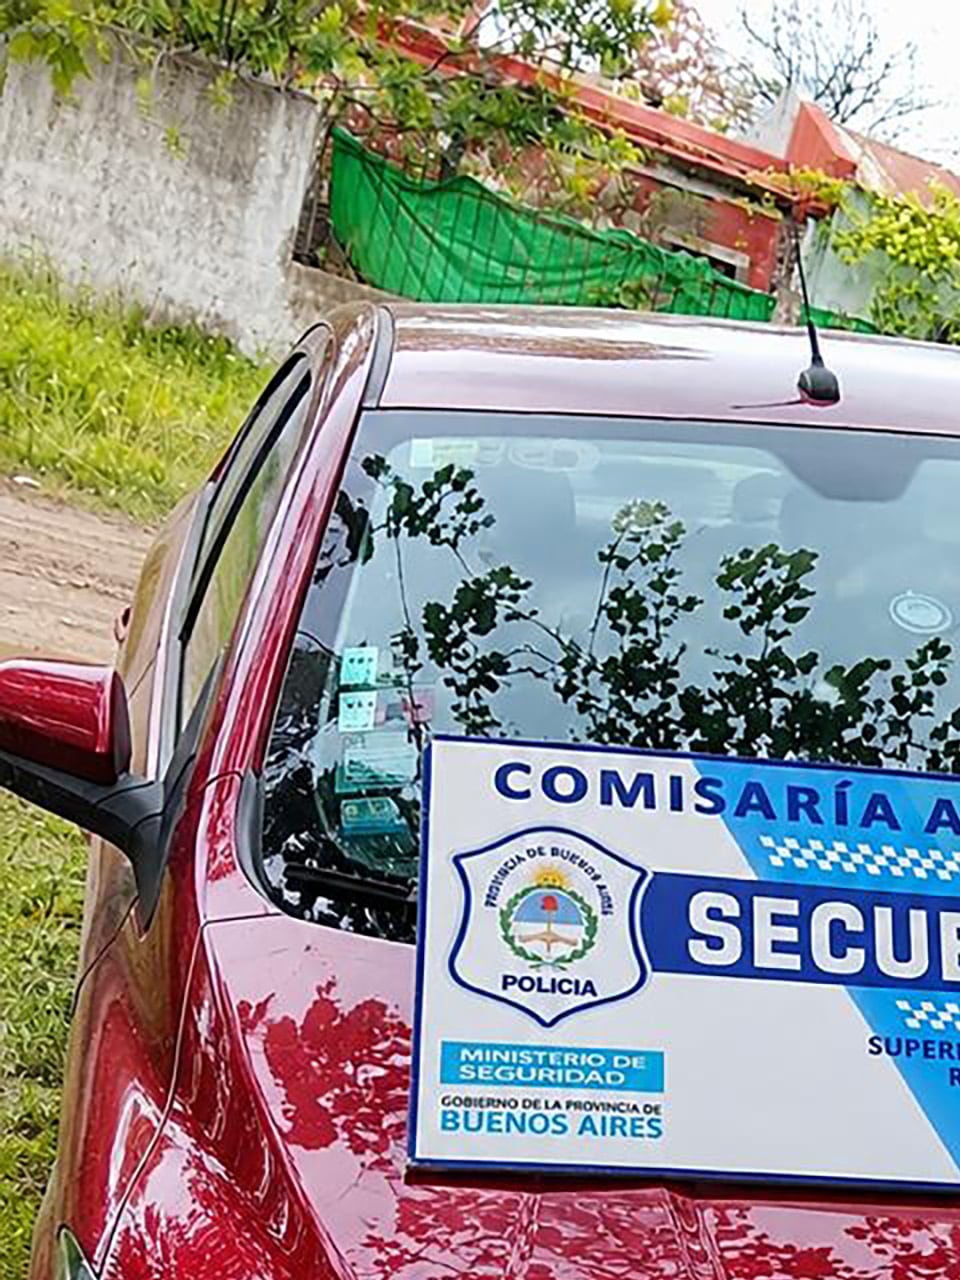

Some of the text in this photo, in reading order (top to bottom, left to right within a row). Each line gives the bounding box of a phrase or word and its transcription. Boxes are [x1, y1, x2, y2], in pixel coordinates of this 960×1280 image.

[493, 761, 901, 832] COMISARÍA
[526, 846, 546, 859] DE
[501, 973, 599, 998] POLICIA
[459, 1048, 647, 1069] MINISTERIO DE
[459, 1064, 626, 1086] SEGURIDAD
[440, 1095, 662, 1115] GOBIERNO DE LA PROVINCIA DE
[440, 1109, 663, 1139] BUENOS AIRES
